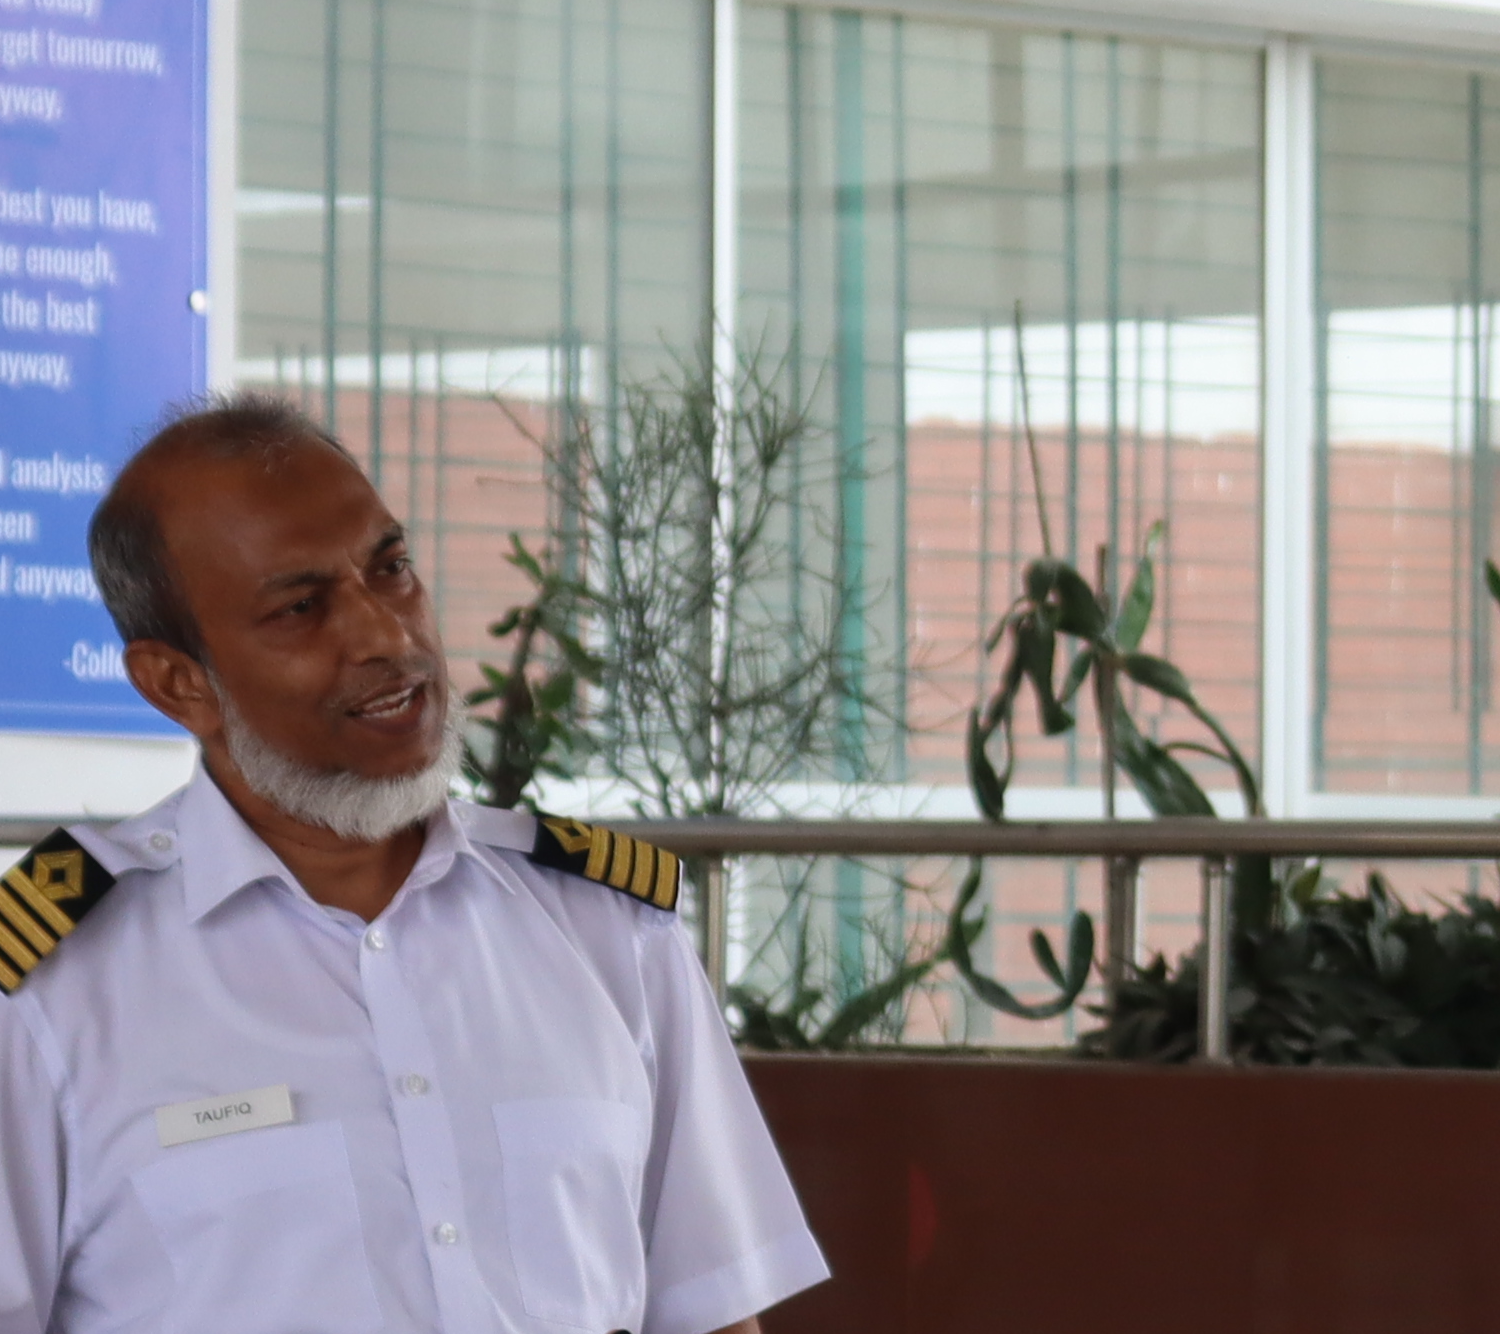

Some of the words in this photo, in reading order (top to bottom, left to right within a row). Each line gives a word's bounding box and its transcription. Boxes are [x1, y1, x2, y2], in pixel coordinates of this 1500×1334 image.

[51, 193, 90, 230] you
[2, 289, 39, 329] the
[46, 289, 96, 333] best
[193, 1102, 252, 1125] TAUFIQ
